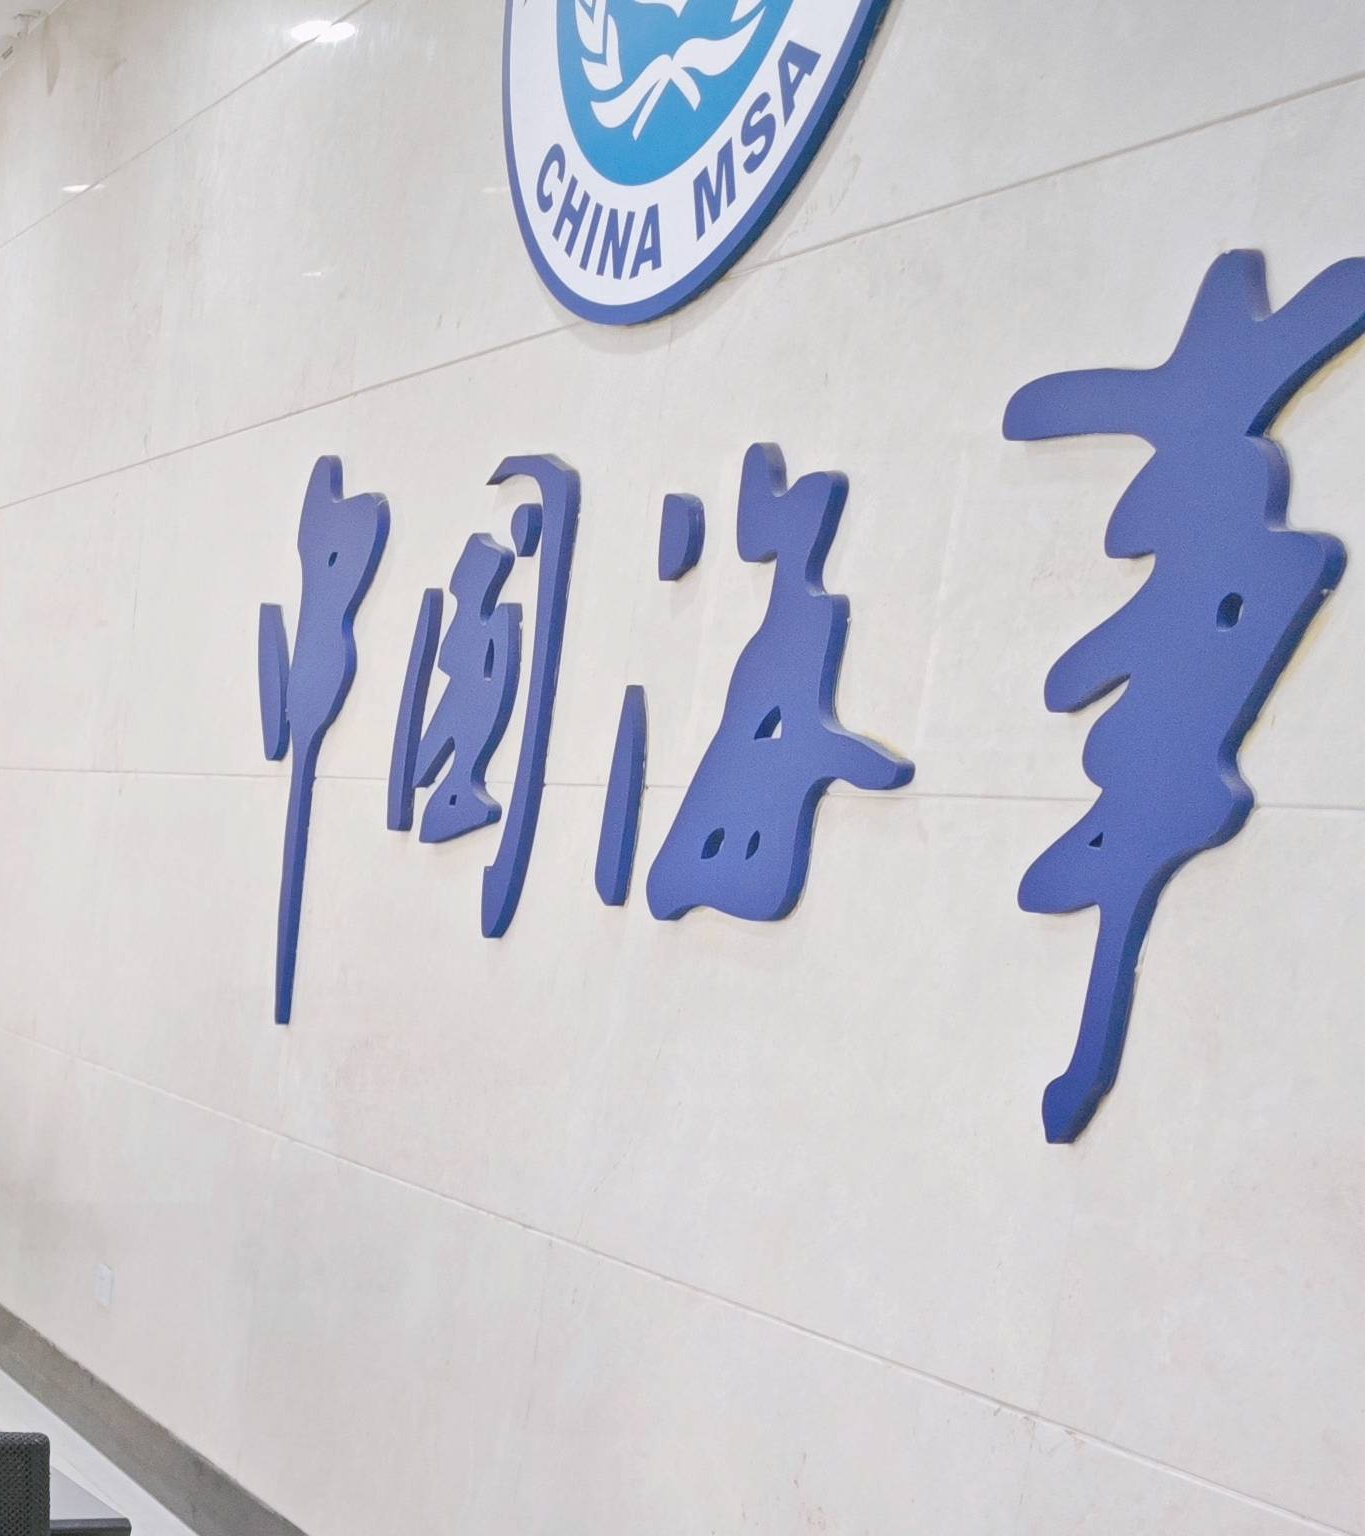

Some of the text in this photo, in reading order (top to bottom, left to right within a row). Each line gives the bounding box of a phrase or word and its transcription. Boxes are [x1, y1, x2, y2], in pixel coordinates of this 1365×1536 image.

[536, 40, 822, 281] CHINA MSA
[257, 248, 1365, 1144] 中国海事
